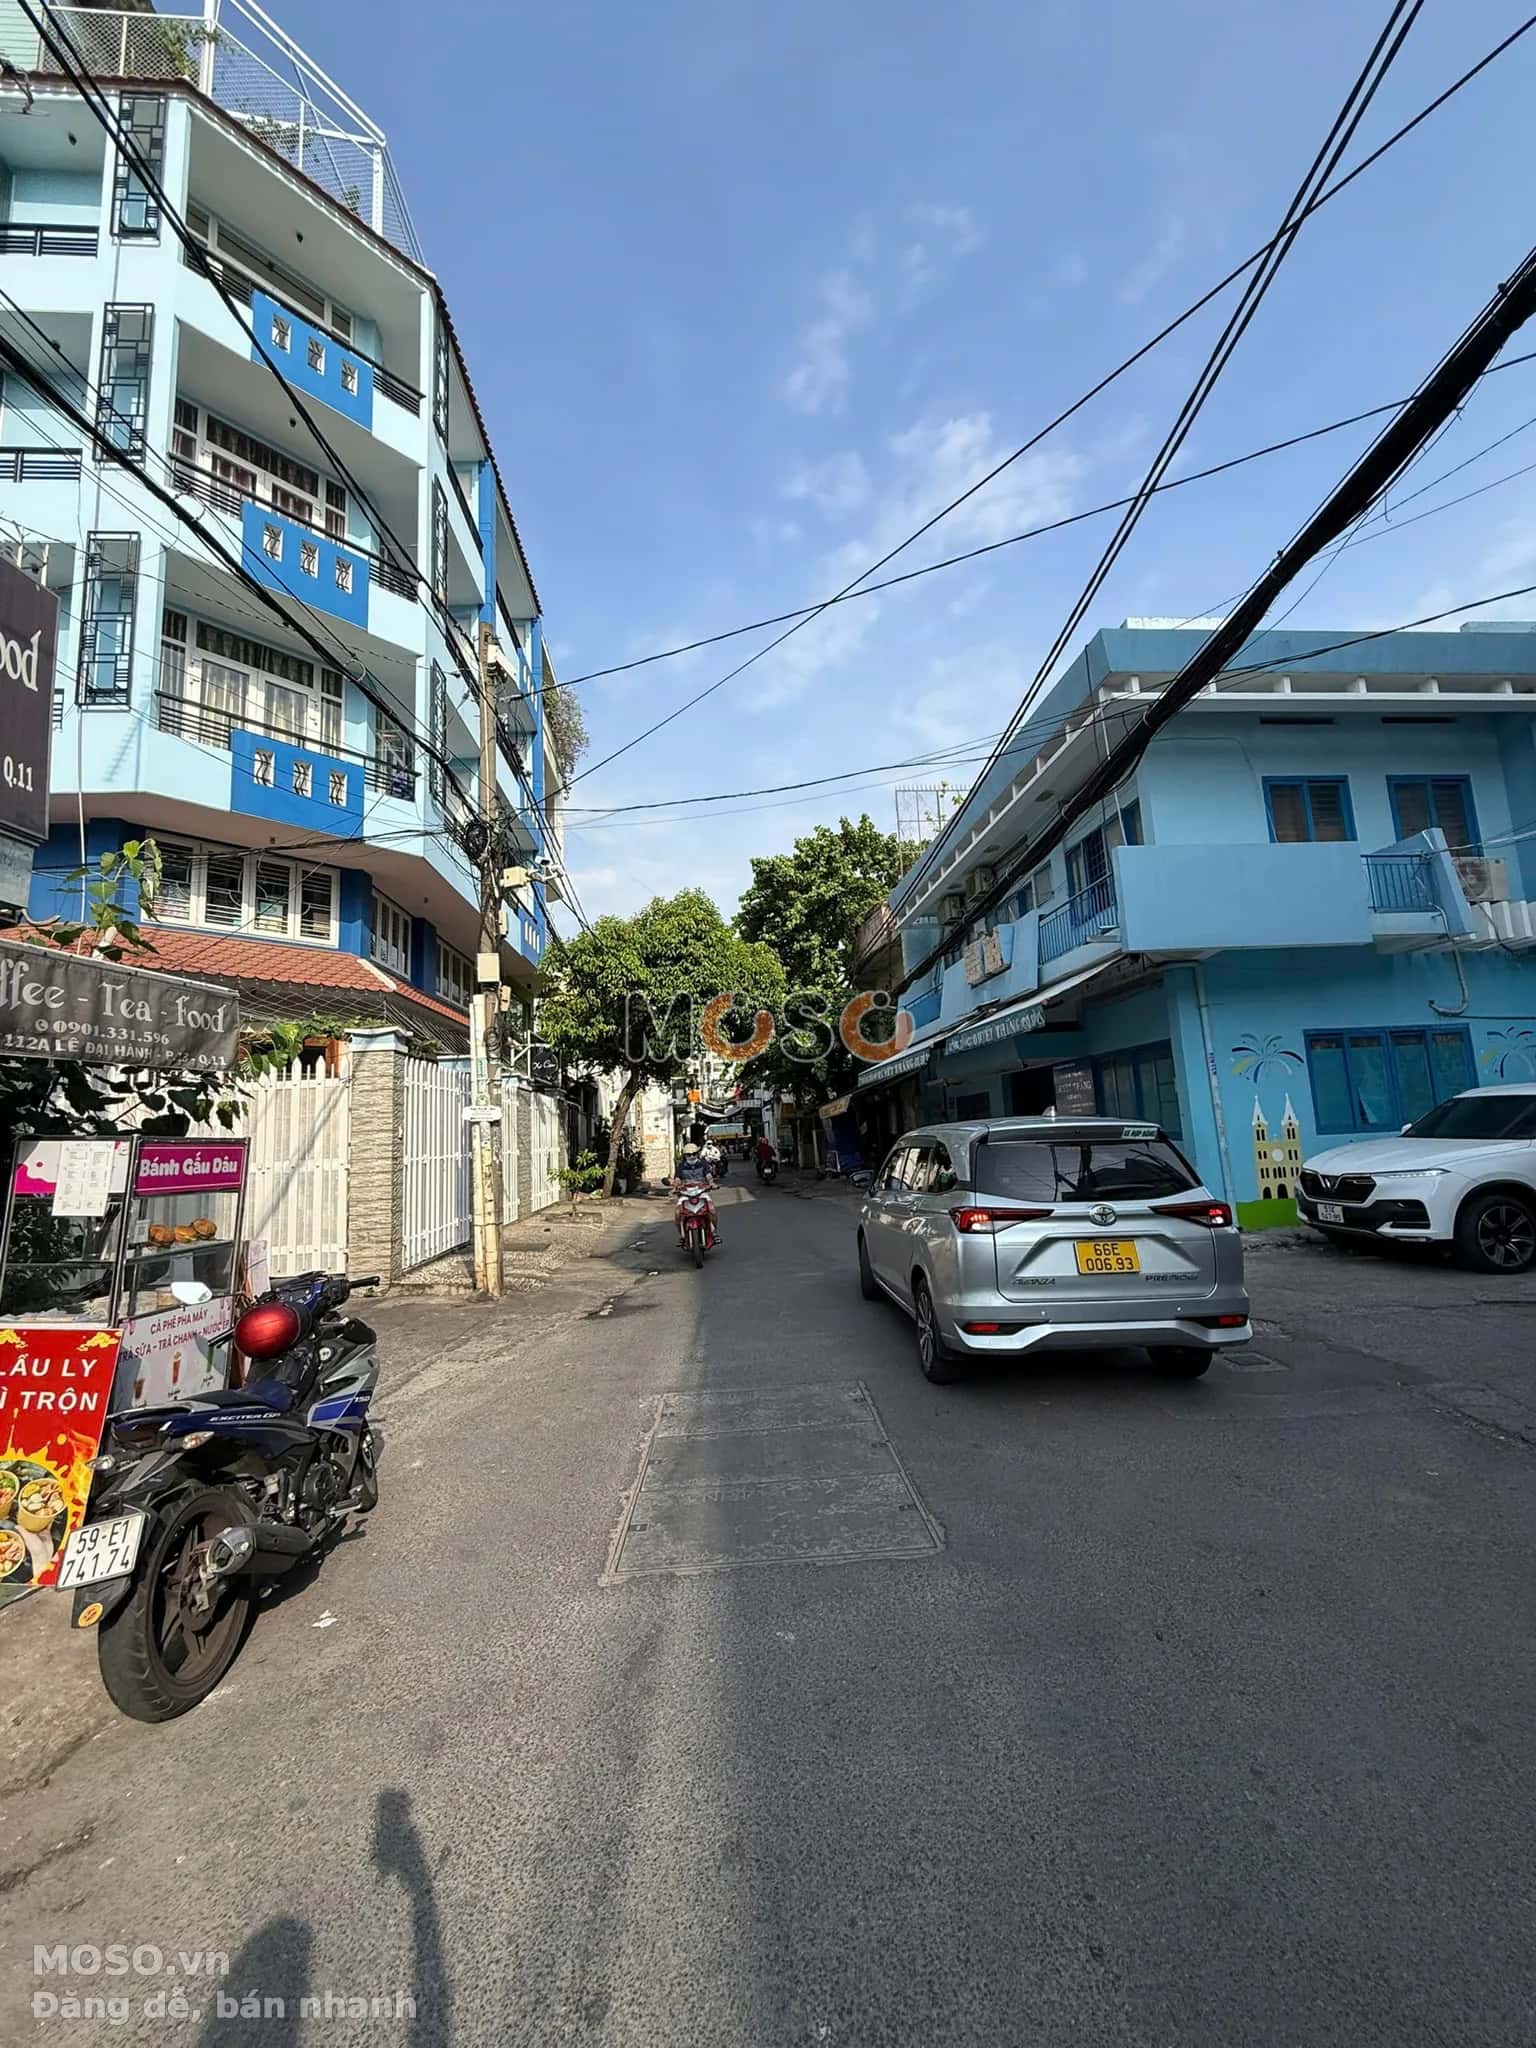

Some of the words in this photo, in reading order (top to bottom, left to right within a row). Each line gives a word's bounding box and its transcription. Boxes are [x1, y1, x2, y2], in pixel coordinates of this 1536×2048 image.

[3, 755, 33, 792] Q.11
[98, 981, 153, 1021] Tea
[53, 1020, 170, 1046] 0901.331.596
[4, 1033, 50, 1053] 112A
[55, 1037, 80, 1053] LÊ
[85, 1041, 109, 1058] ĐẠI
[115, 1042, 153, 1060] HÀNH
[140, 1156, 180, 1177] Bánh
[183, 1151, 211, 1176] Gấu
[213, 1156, 238, 1174] Dâu
[1093, 1242, 1120, 1257] 66E
[1086, 1257, 1134, 1272] 006.93
[162, 1314, 177, 1332] PHÊ
[177, 1313, 192, 1326] PHA
[192, 1308, 208, 1322] MÁY
[61, 1358, 98, 1378] LY
[20, 1387, 98, 1415] TRỘN
[76, 1519, 130, 1554] 59-E1
[62, 1545, 130, 1586] 741.74
